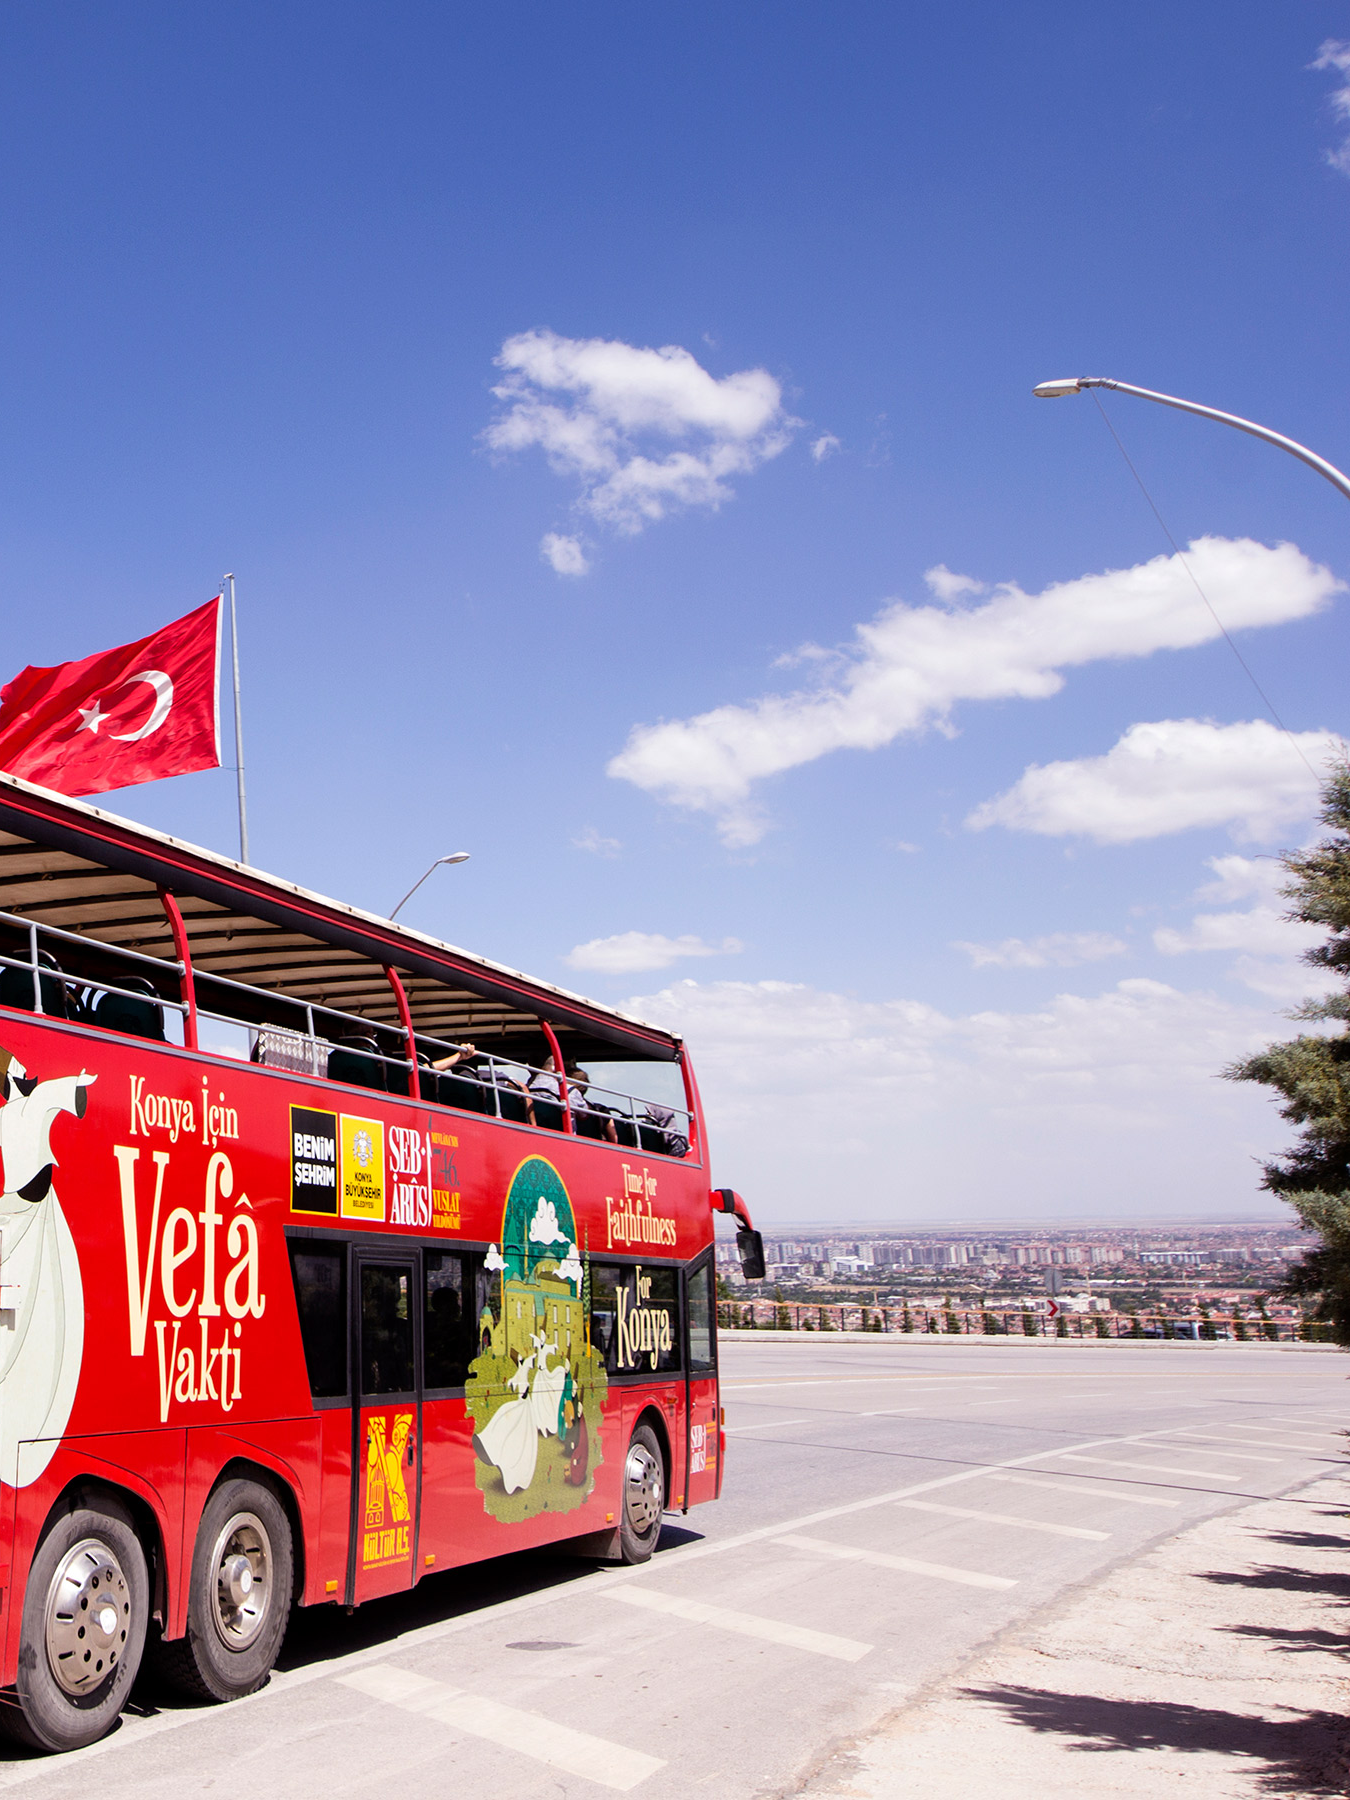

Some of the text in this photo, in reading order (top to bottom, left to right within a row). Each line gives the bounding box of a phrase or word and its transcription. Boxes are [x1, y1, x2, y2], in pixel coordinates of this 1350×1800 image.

[129, 1074, 239, 1149] Konya İçin
[354, 1172, 372, 1184] KONYA
[432, 1188, 461, 1213] VUSLAT
[621, 1163, 658, 1201] Time For
[606, 1196, 677, 1249] Faithfulness
[113, 1145, 266, 1357] Vefâ
[635, 1265, 652, 1306] For
[615, 1286, 672, 1370] Konya
[154, 1318, 243, 1423] Vakti
